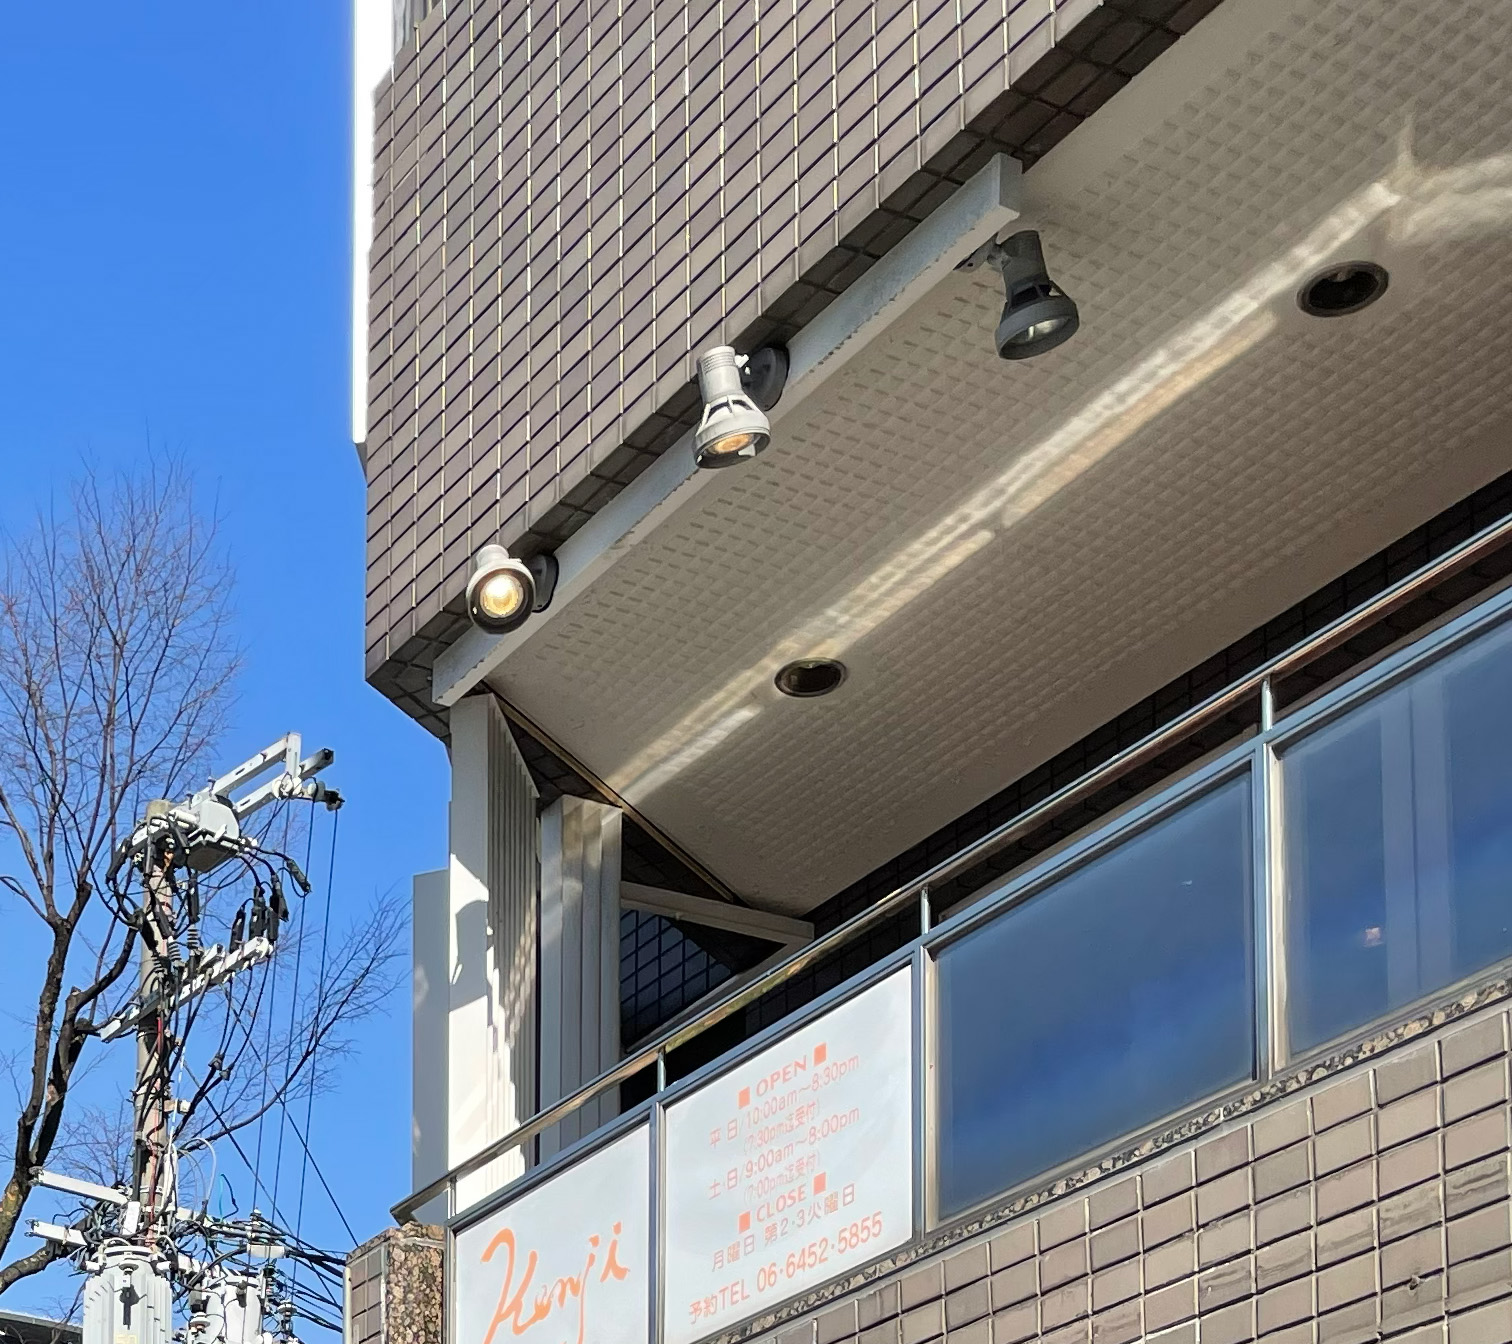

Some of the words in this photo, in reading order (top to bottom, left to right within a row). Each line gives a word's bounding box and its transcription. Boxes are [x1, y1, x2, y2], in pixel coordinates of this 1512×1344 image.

[756, 1055, 807, 1097] OPEN
[757, 1184, 806, 1223] CLOSE
[712, 1234, 756, 1272] 月曜日
[689, 1279, 750, 1325] 予約TEL
